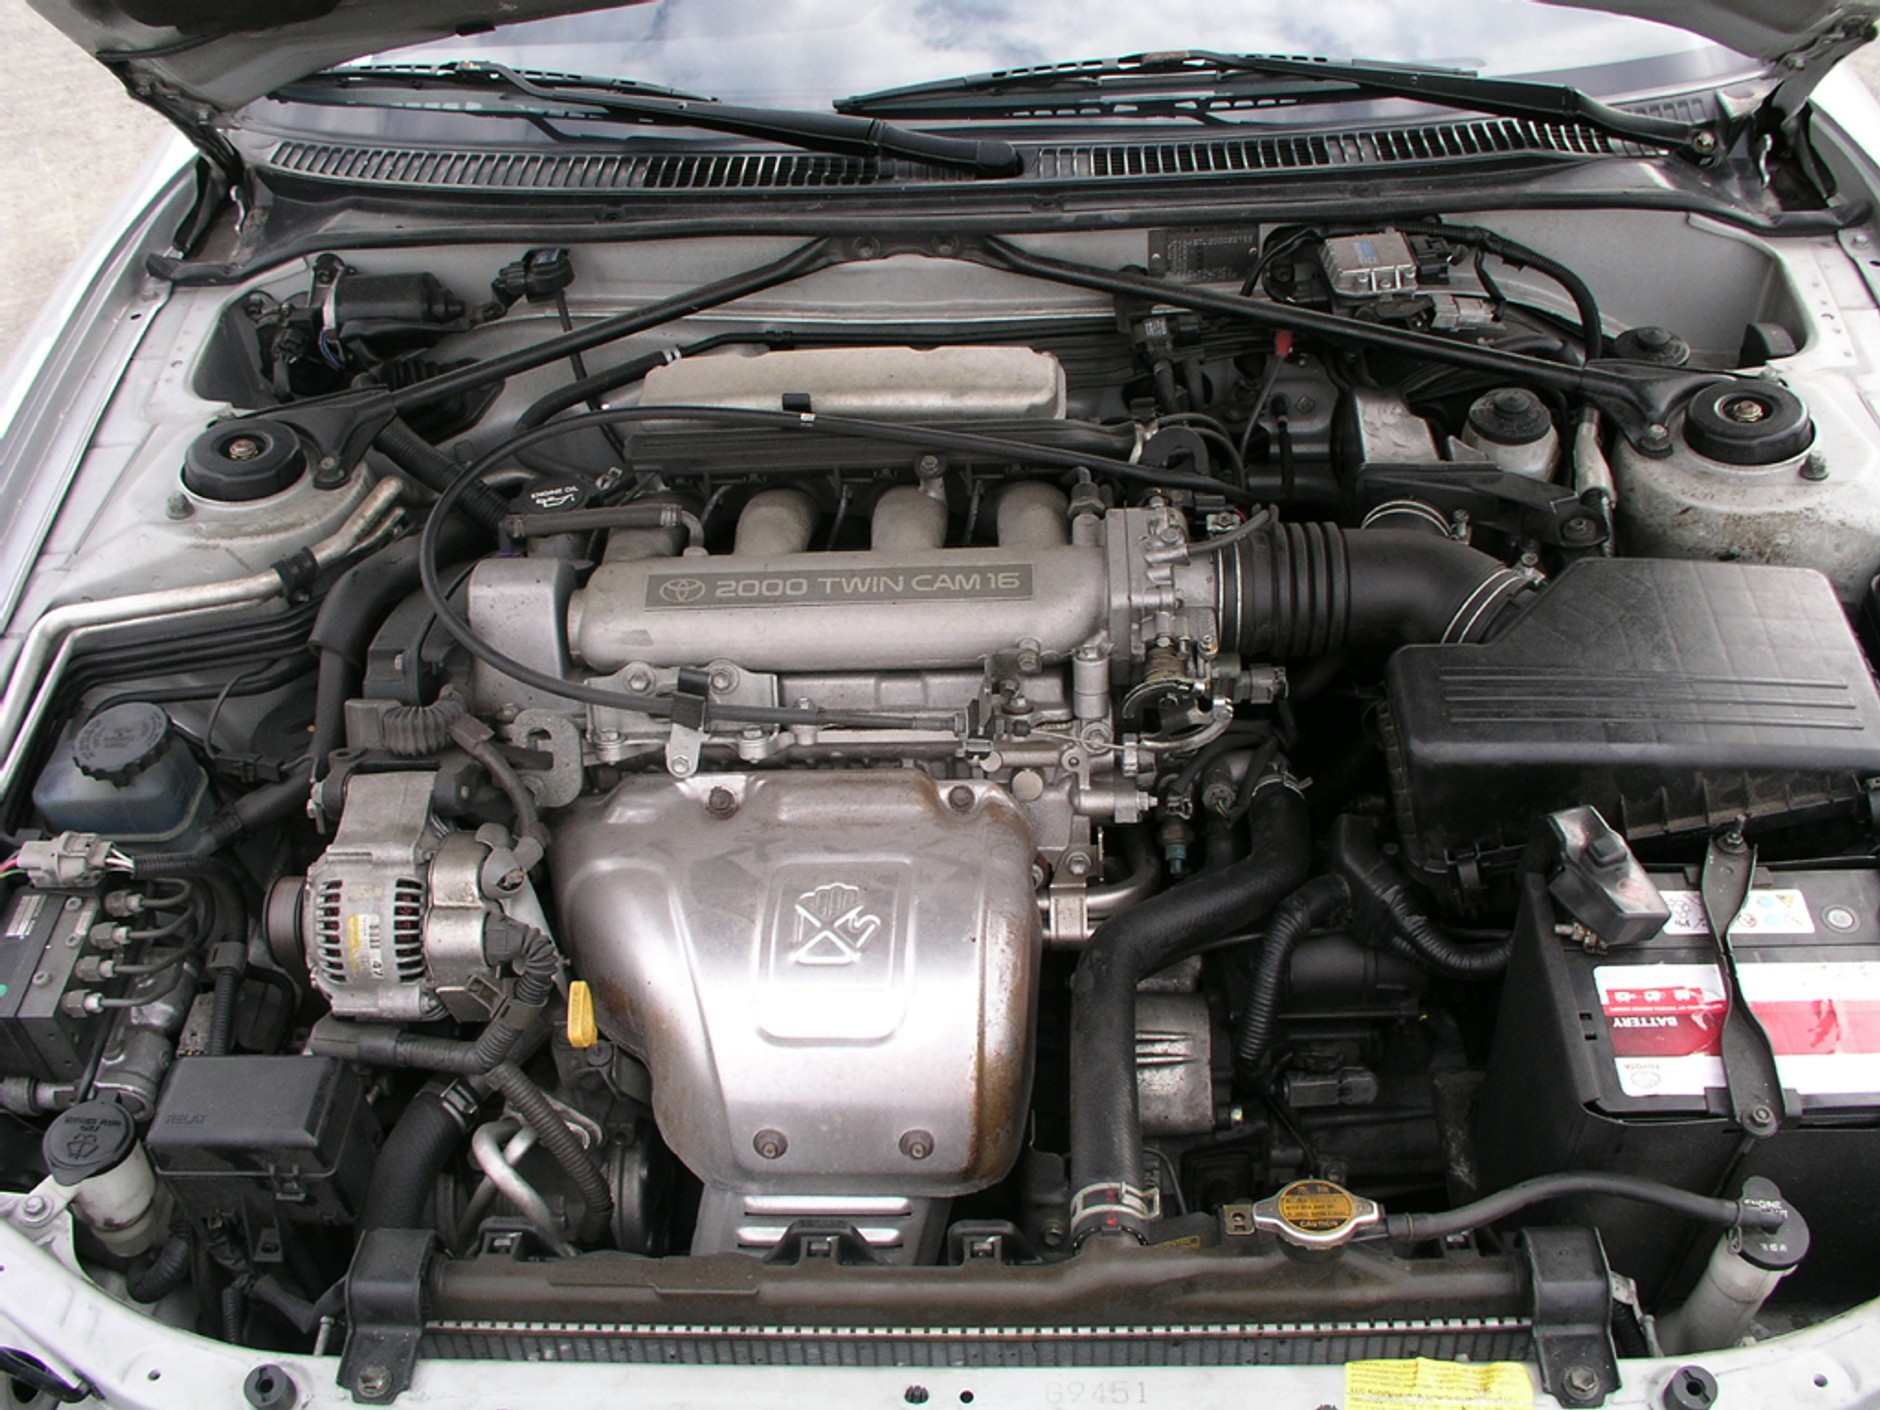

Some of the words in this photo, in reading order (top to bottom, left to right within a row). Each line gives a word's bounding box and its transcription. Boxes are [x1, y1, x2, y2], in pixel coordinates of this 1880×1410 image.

[530, 488, 563, 499] ENGINE
[715, 578, 808, 598] 2000
[817, 575, 905, 595] TWIN
[1613, 1016, 1678, 1028] BATTERY
[166, 1114, 207, 1124] RELAY
[1299, 1219, 1339, 1228] CAUTION
[1044, 1380, 1147, 1404] G9451
